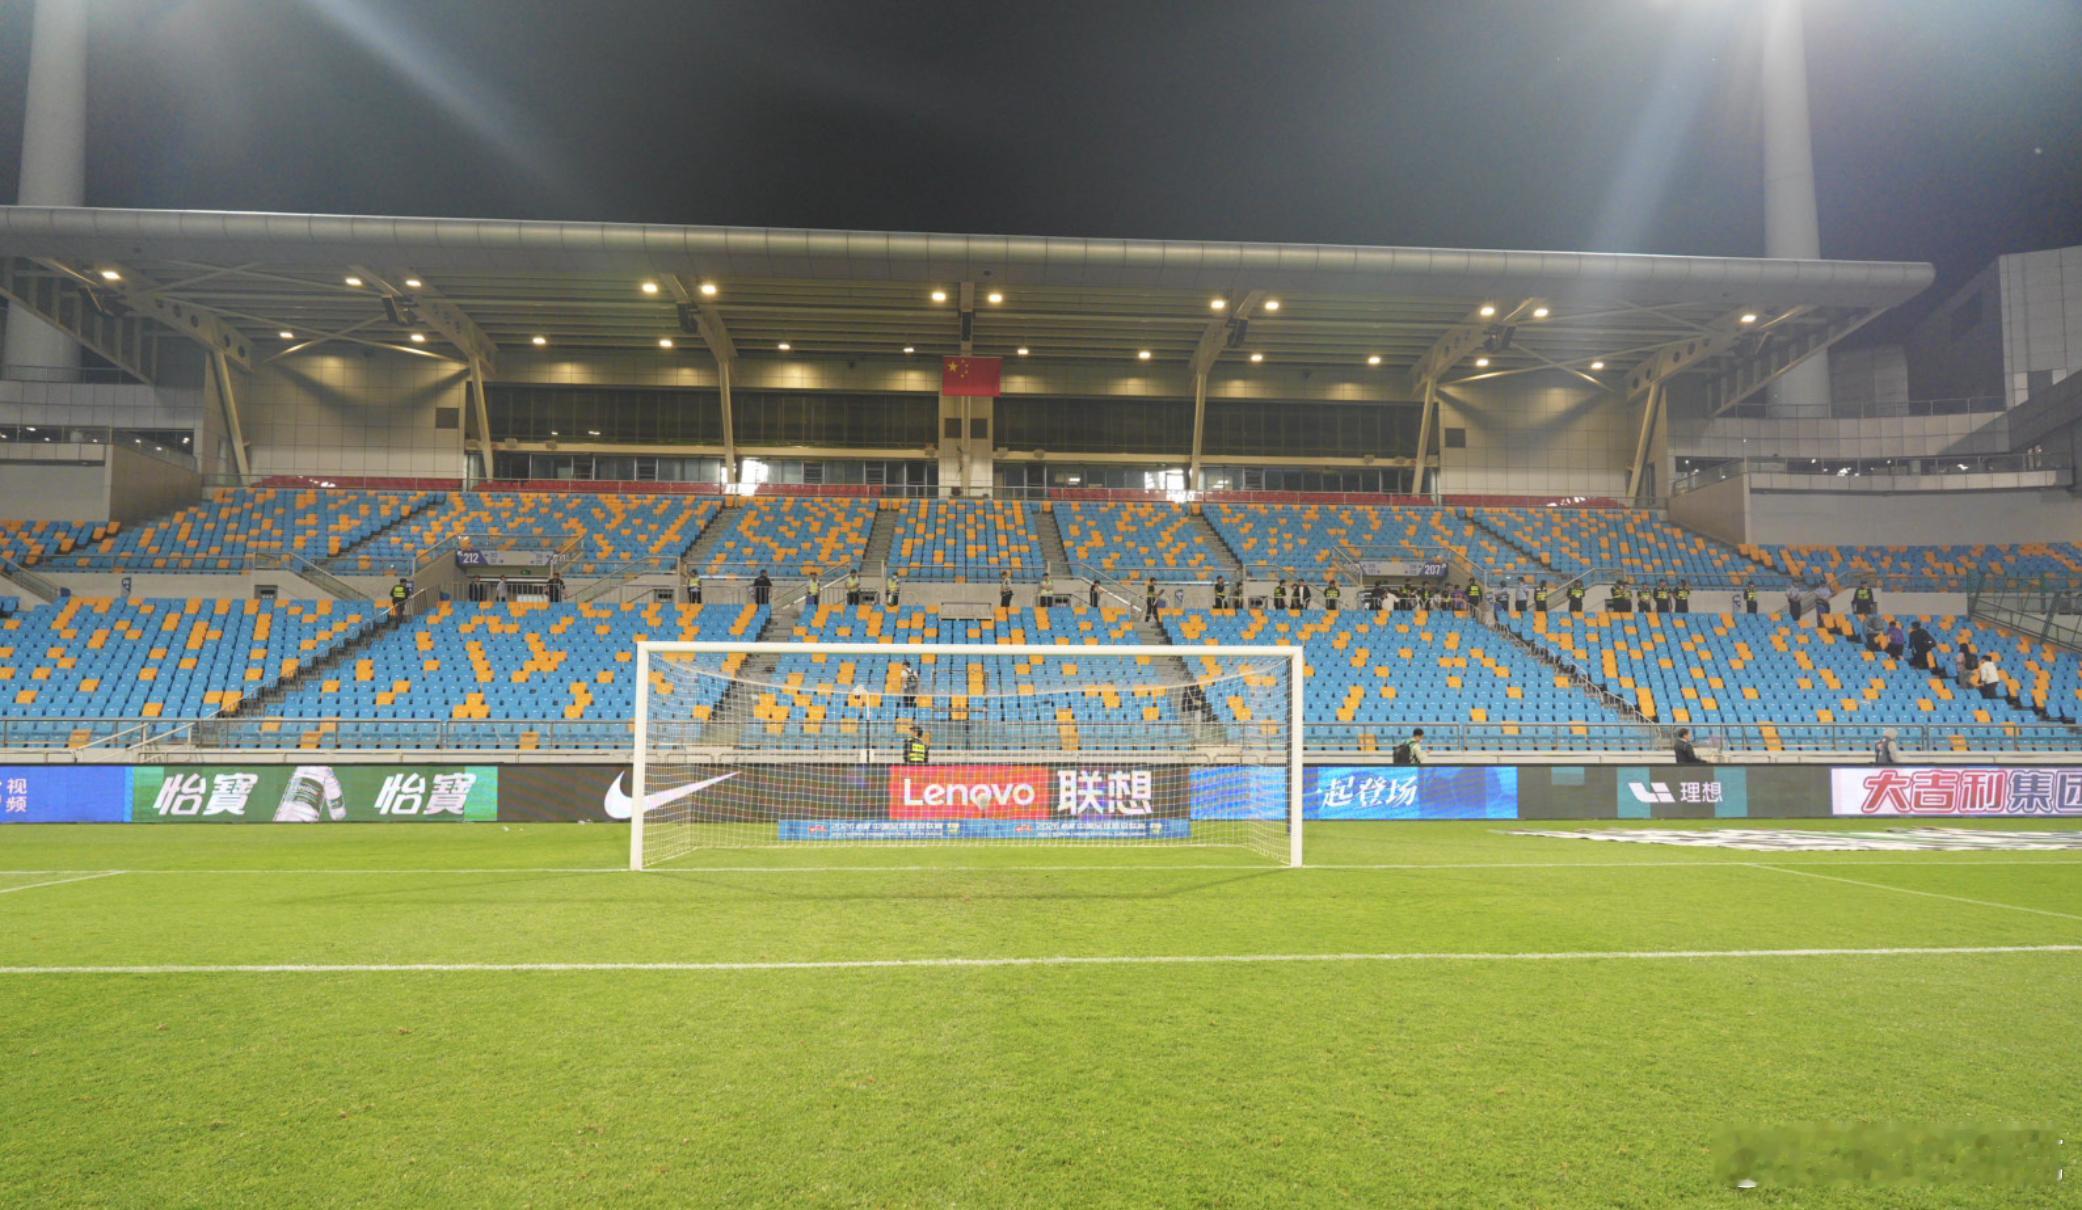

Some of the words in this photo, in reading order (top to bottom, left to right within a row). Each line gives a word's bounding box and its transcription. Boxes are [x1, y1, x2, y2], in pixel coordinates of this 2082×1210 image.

[6, 778, 28, 813] 视频
[153, 773, 258, 816] 怡寶
[374, 772, 477, 815] 怡寶
[904, 778, 1036, 807] Lenovo
[1057, 769, 1152, 815] 联想
[1680, 781, 1724, 803] 理想
